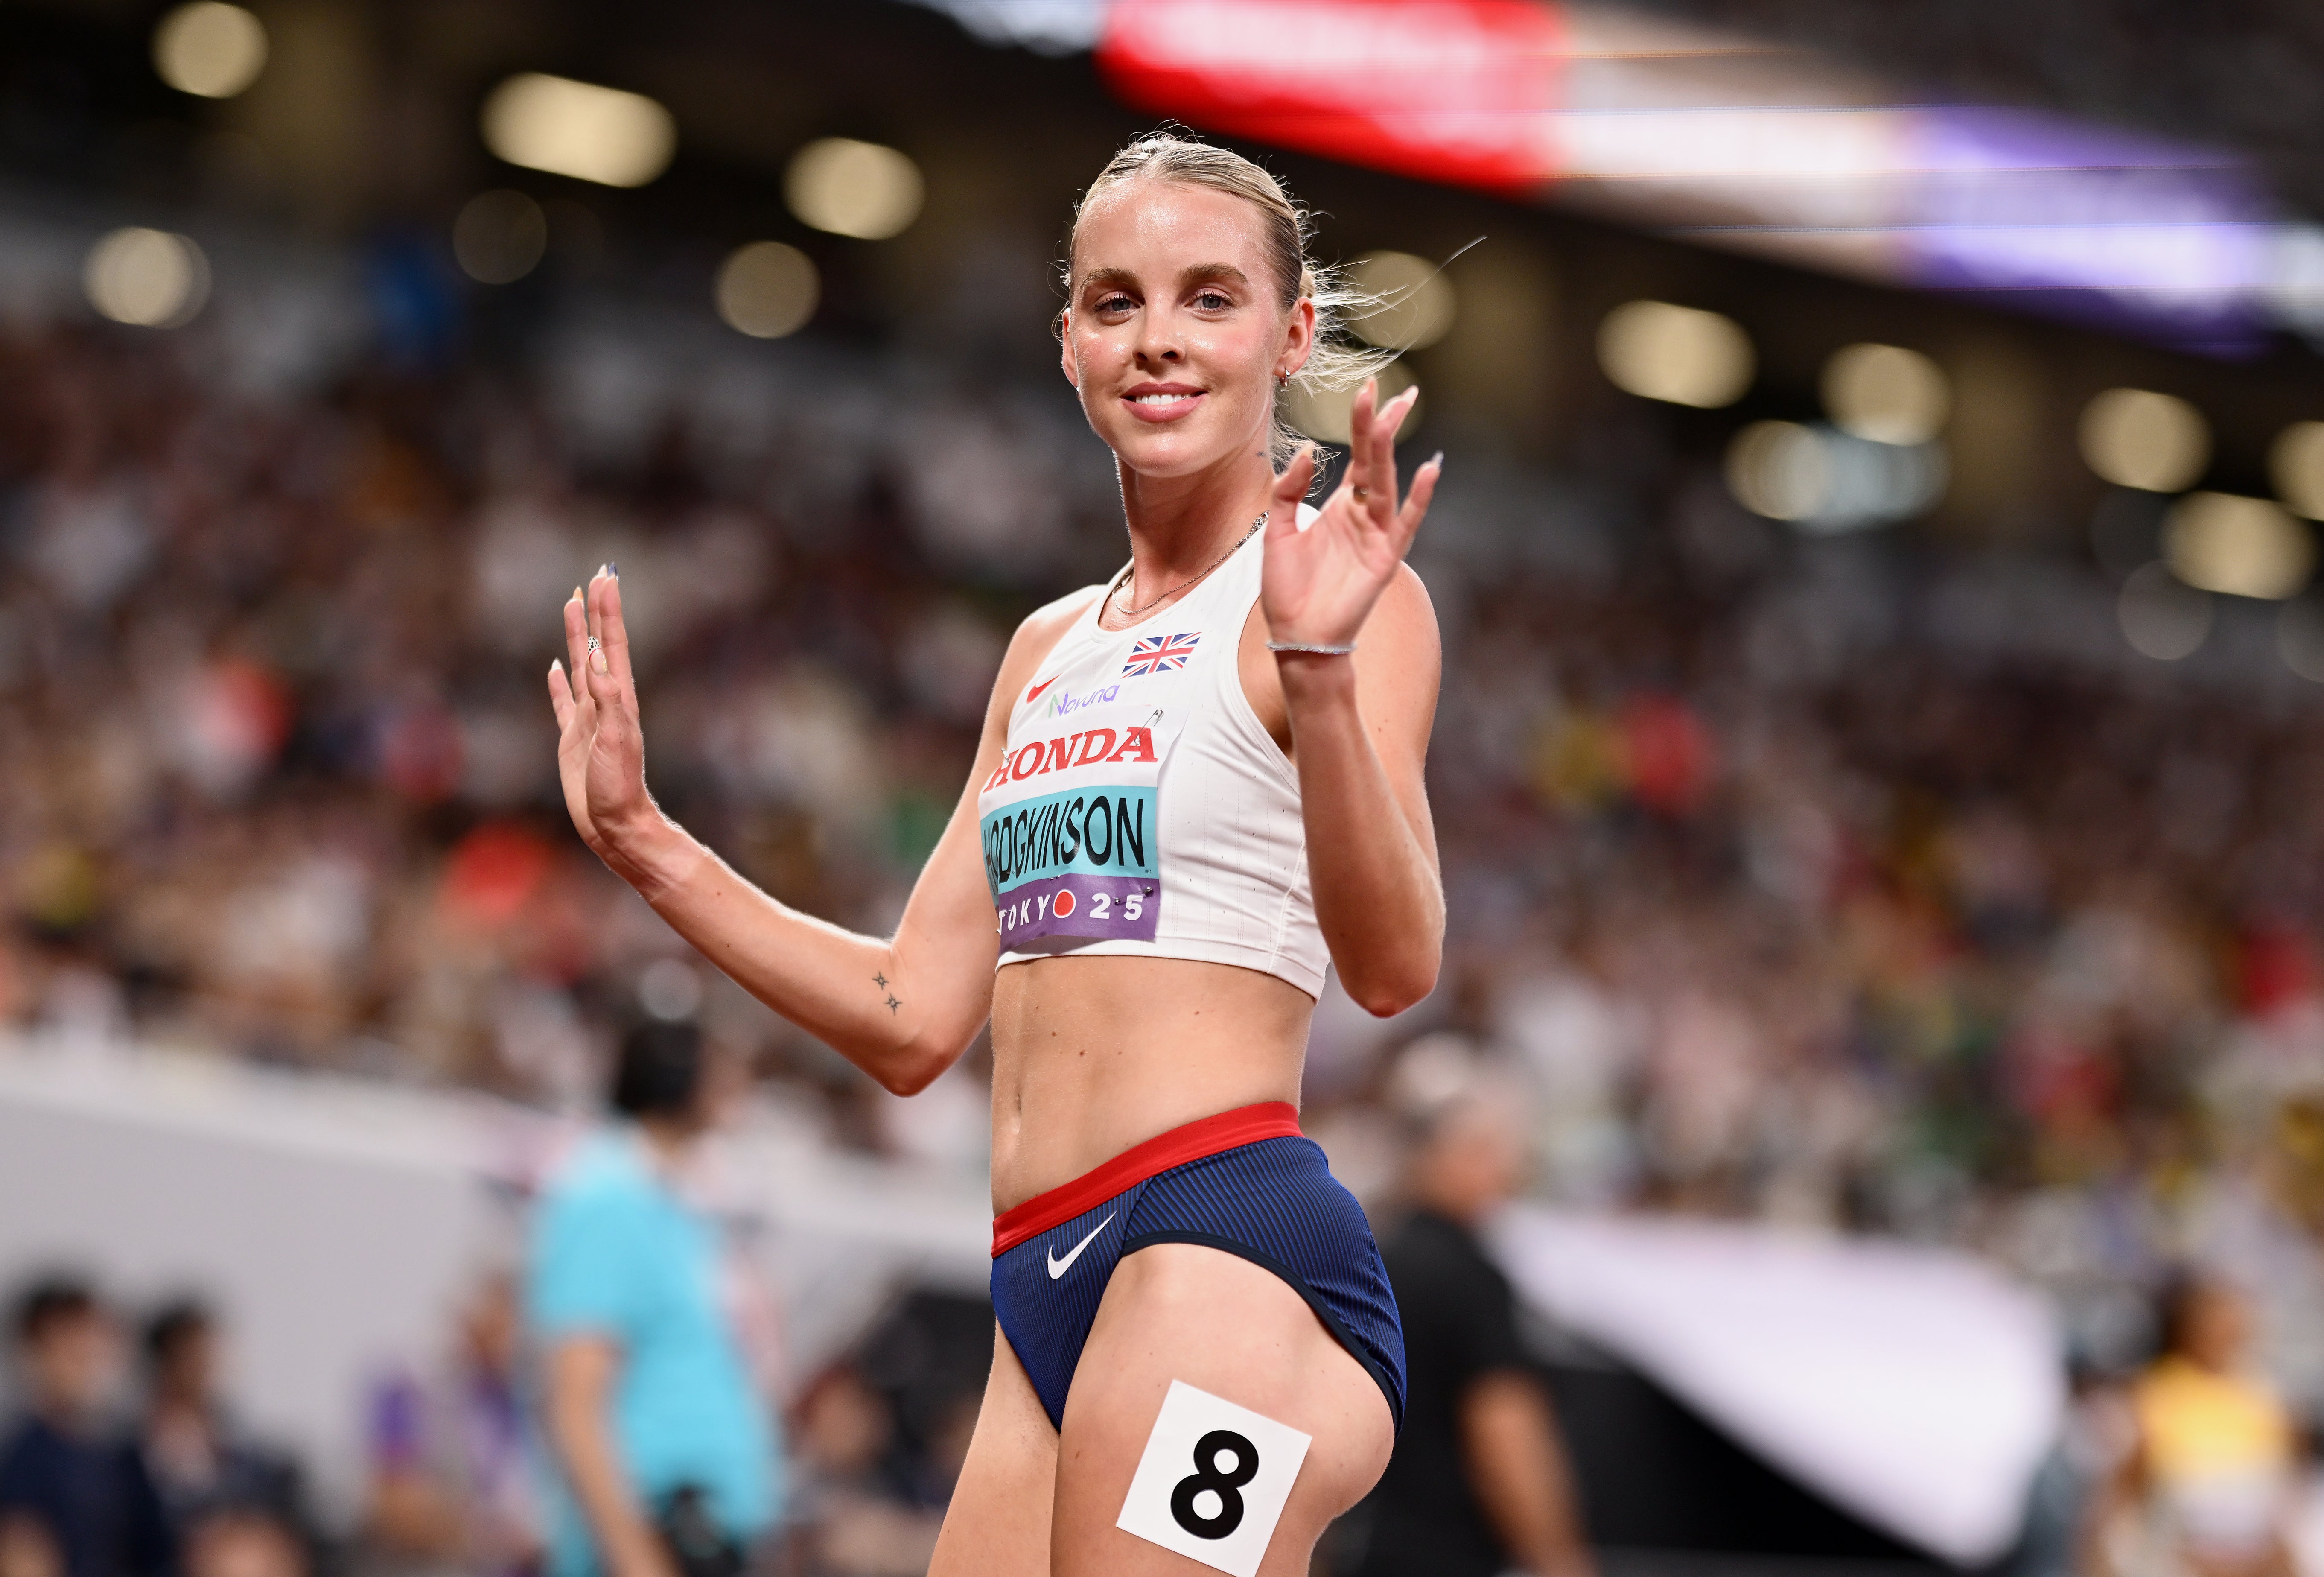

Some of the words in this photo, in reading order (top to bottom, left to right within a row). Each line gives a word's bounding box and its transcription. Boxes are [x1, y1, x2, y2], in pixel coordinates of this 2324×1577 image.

[1048, 685, 1120, 718] Novuna
[983, 727, 1159, 794] HONDA
[983, 795, 1145, 896] HODGKINSON
[1170, 1430, 1259, 1541] 8
